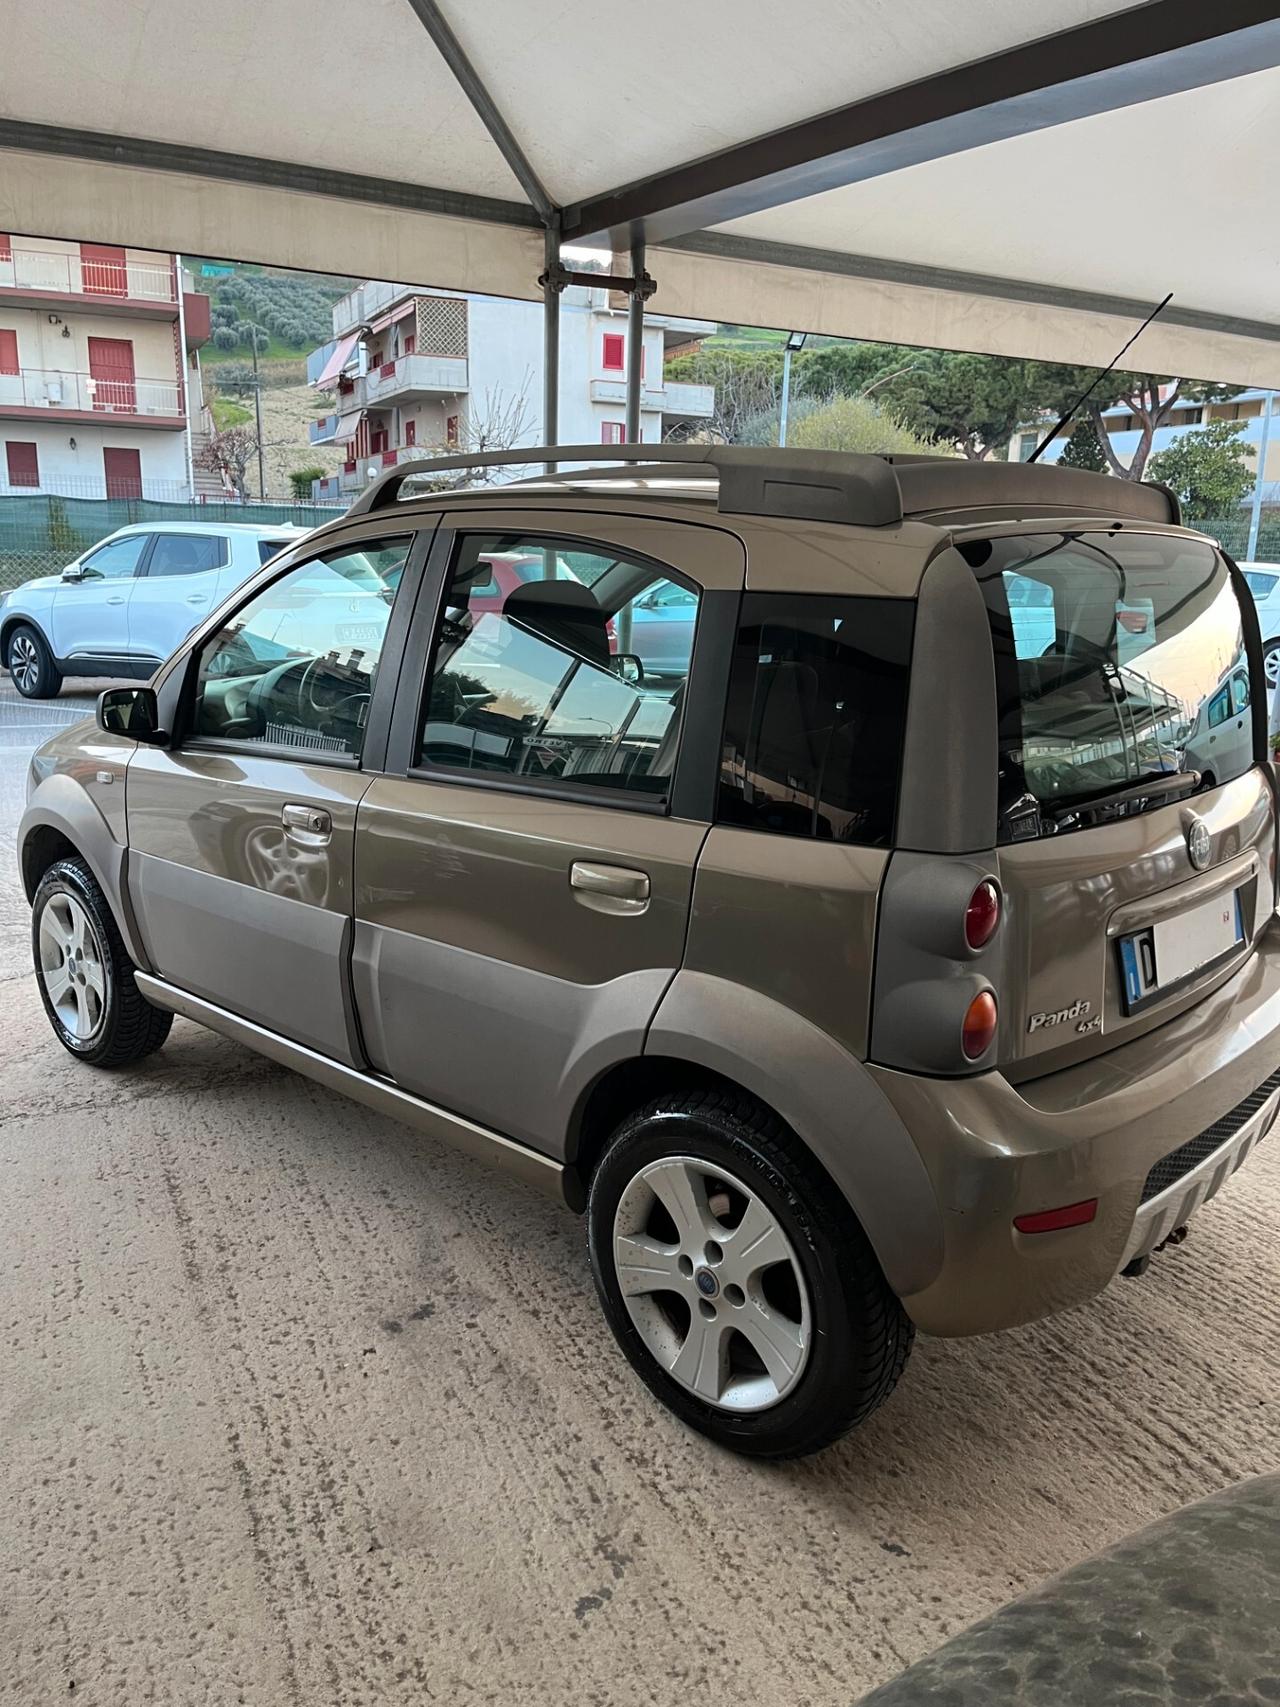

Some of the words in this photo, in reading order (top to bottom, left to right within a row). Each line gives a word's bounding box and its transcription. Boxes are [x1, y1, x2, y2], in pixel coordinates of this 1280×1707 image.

[1195, 836, 1210, 855] FIAT
[1028, 999, 1091, 1033] Panda
[1076, 1015, 1102, 1033] 4x4
